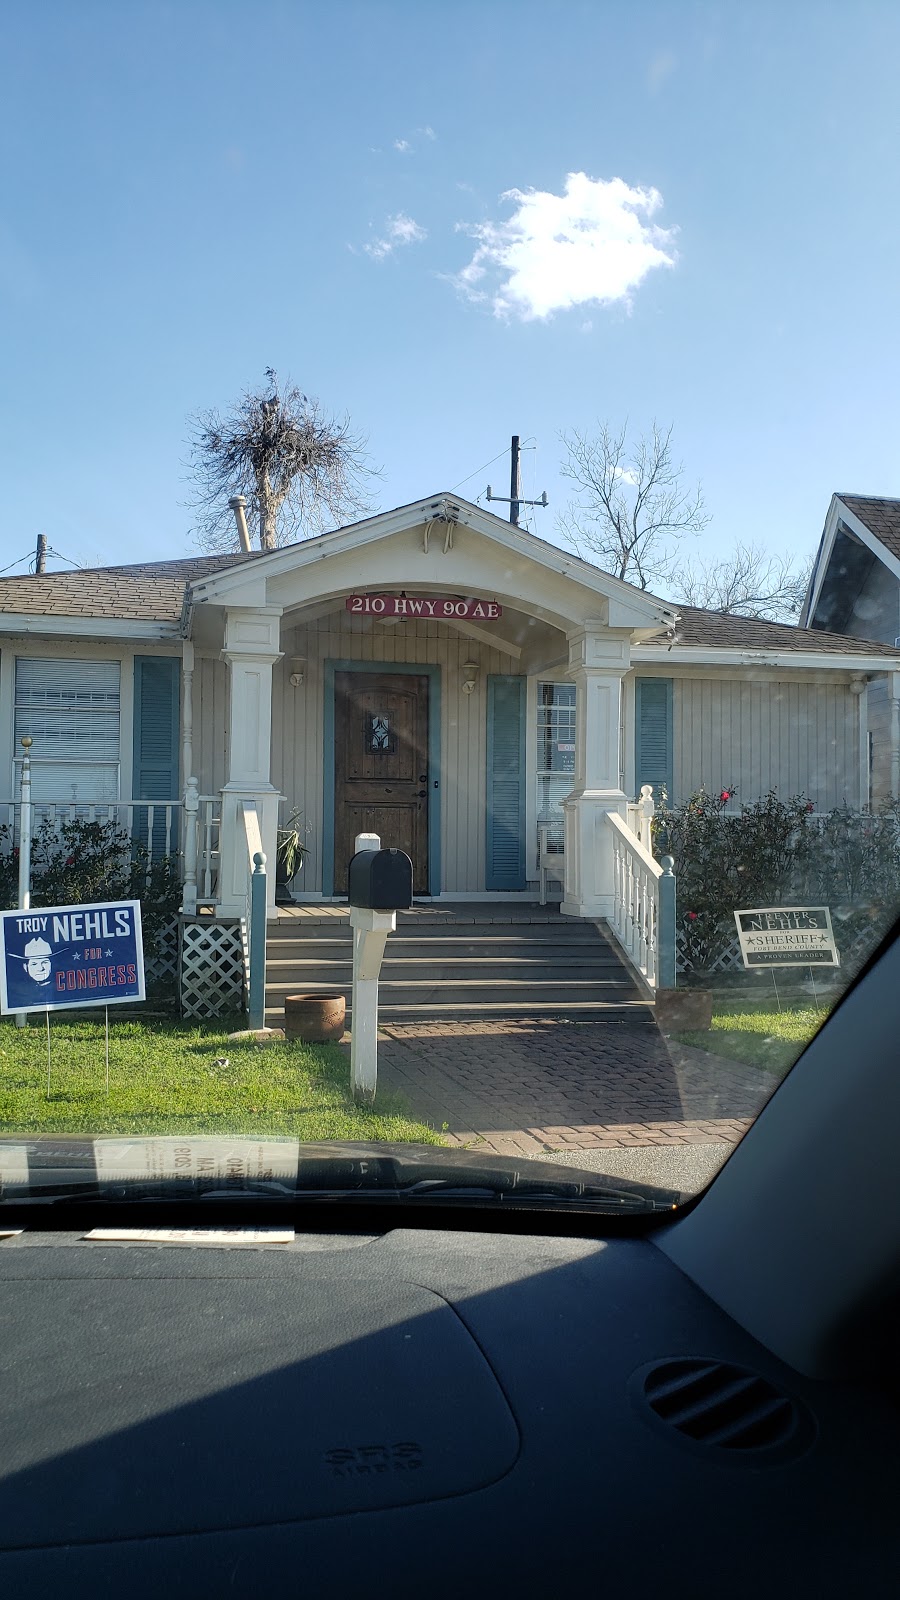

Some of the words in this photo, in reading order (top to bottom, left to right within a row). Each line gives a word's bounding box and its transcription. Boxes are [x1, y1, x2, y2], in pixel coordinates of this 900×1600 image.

[351, 597, 385, 612] 210
[394, 599, 438, 615] HWY
[443, 602, 469, 616] 90
[472, 603, 499, 618] AE
[755, 911, 810, 921] TREVER
[16, 916, 48, 934] TROY
[52, 909, 131, 943] NEHLS
[750, 917, 818, 931] NEHLS
[756, 934, 818, 946] SHERIFF
[84, 947, 103, 961] FOR
[55, 963, 137, 992] CONGRESS
